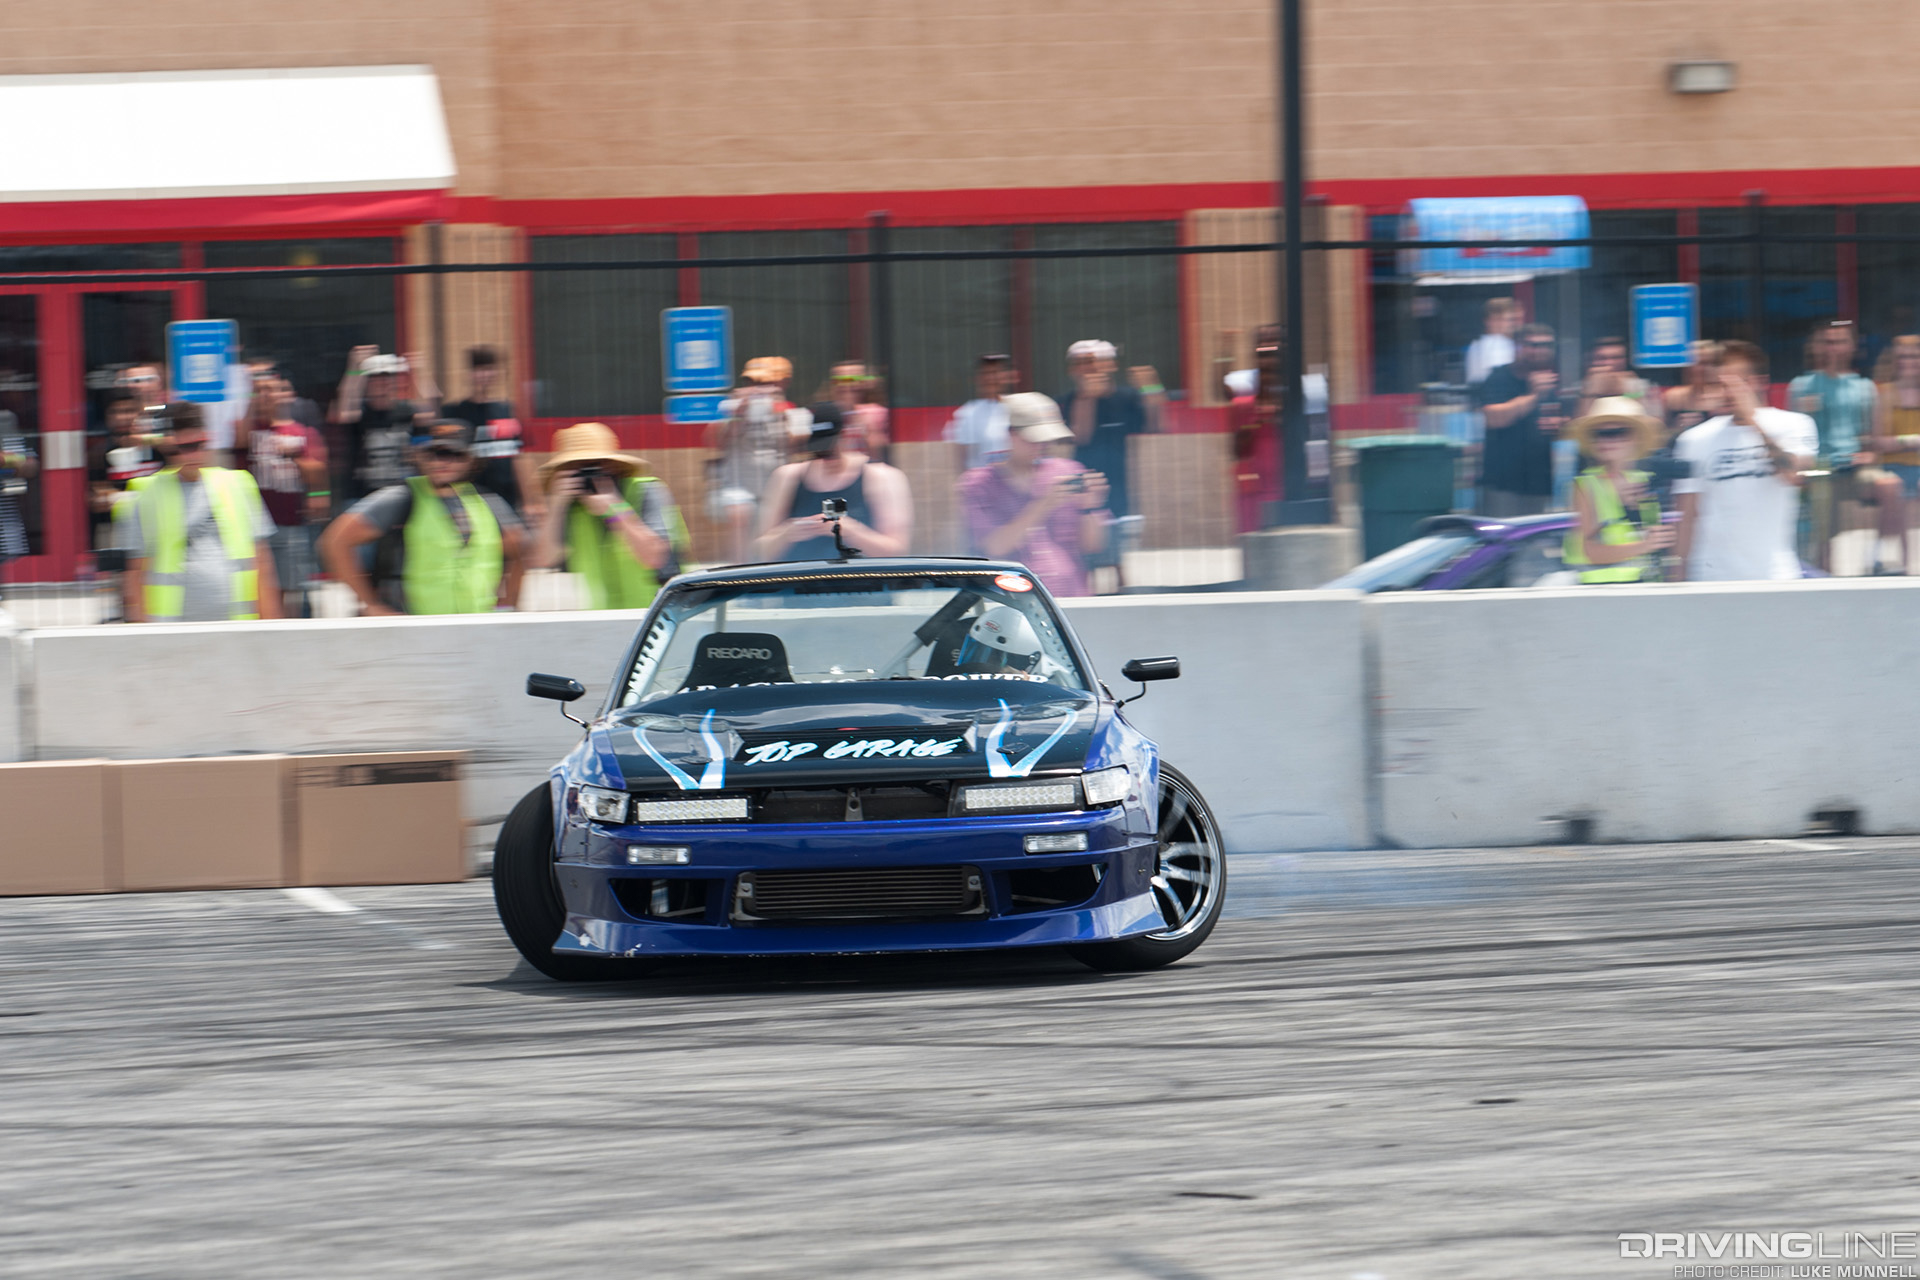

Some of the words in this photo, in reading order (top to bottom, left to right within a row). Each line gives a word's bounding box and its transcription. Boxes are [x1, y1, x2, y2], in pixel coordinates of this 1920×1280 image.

[706, 647, 772, 660] RECARO
[744, 741, 818, 766] TOP
[823, 738, 963, 759] GARAGE
